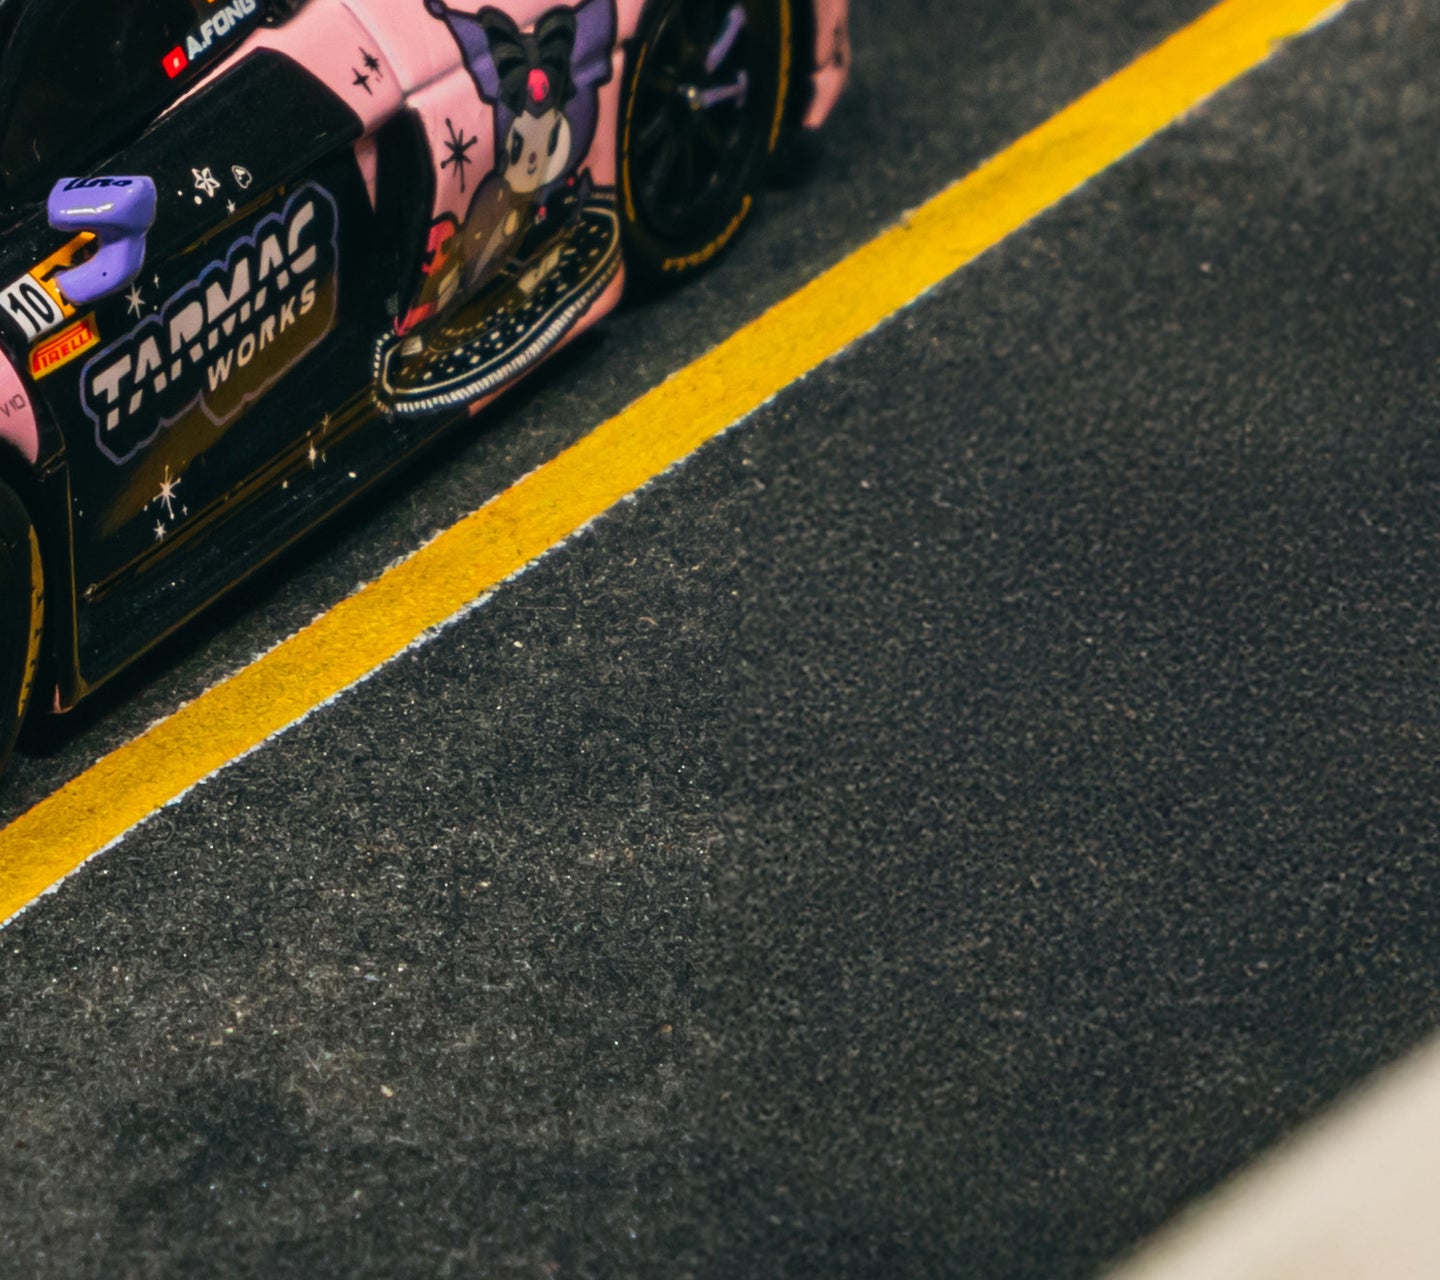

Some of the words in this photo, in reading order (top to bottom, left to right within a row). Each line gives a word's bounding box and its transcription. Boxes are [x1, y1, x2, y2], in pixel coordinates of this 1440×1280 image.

[6, 282, 56, 334] 10
[32, 319, 94, 374] PIRELLI
[92, 200, 317, 432] TARMAC
[207, 279, 317, 392] WORKS
